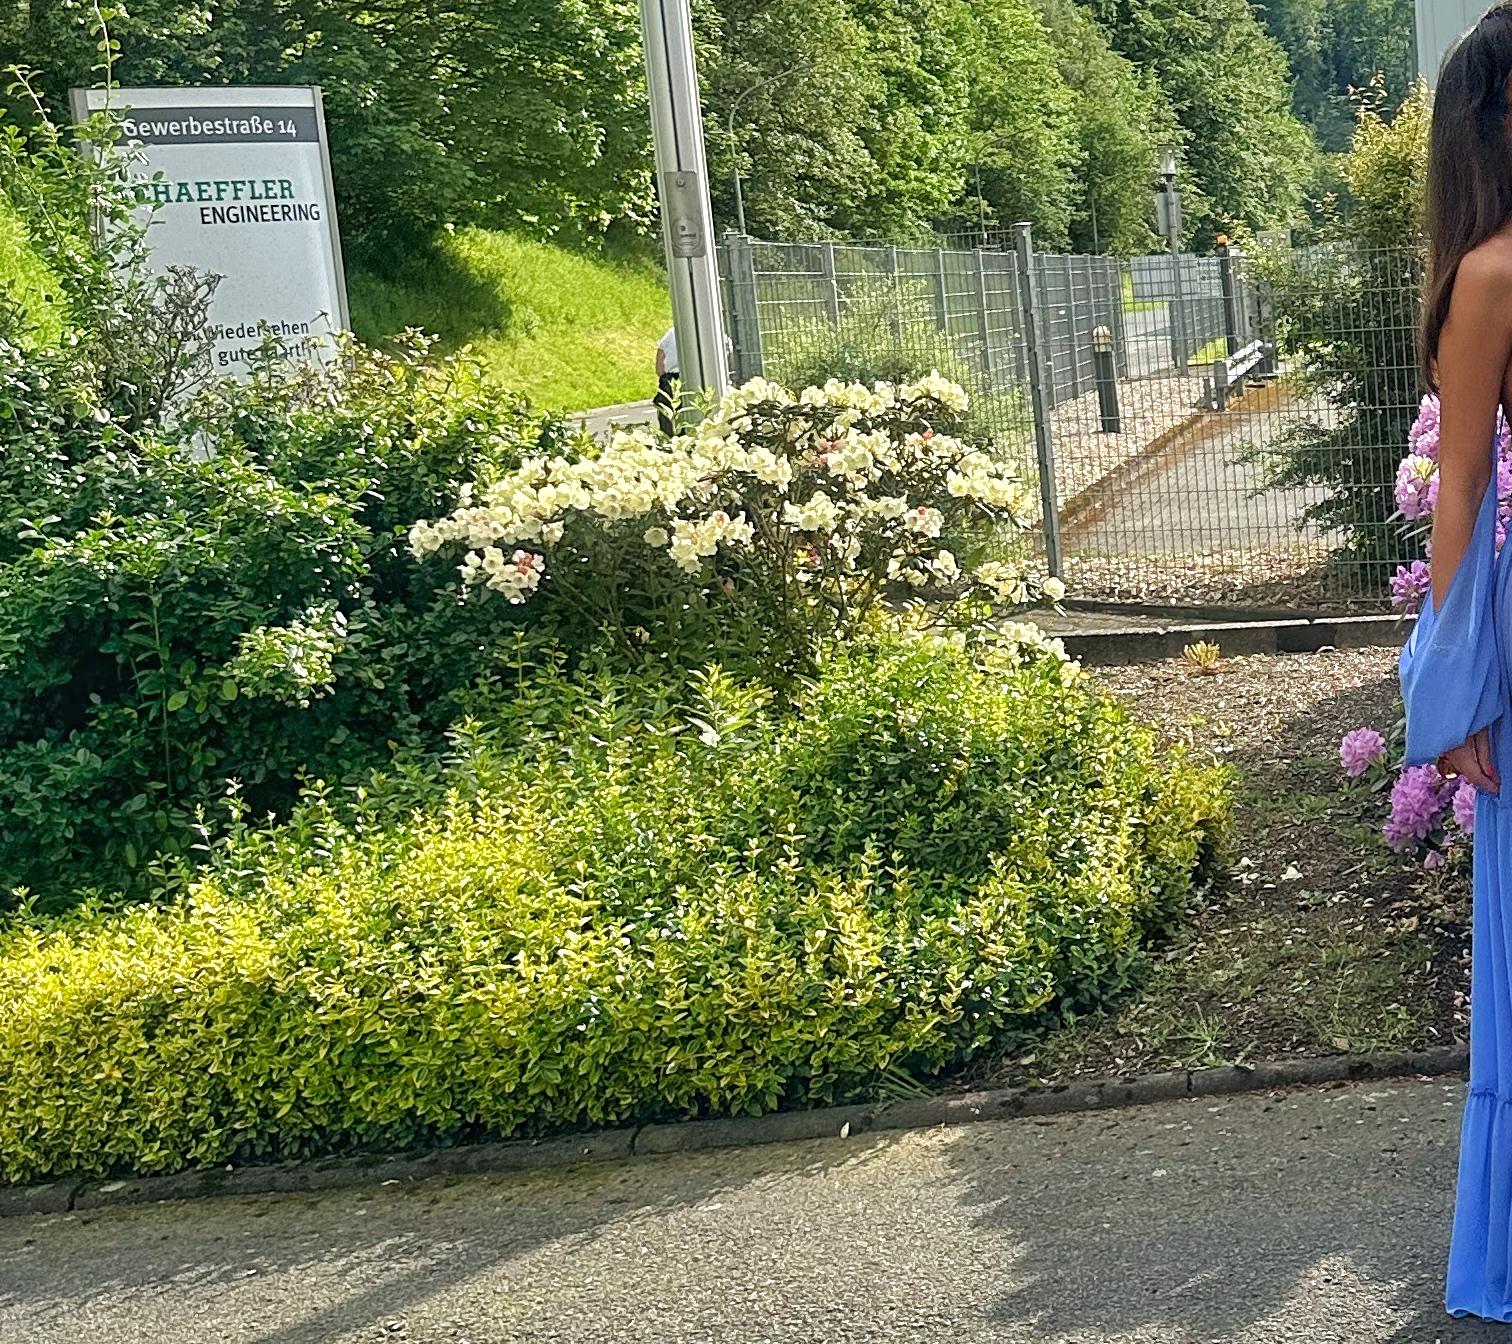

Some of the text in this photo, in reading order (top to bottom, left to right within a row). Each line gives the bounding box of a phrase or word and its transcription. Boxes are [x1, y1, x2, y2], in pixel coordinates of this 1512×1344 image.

[123, 115, 297, 138] Gewerbestraße 14
[200, 203, 321, 225] ENGINEERING
